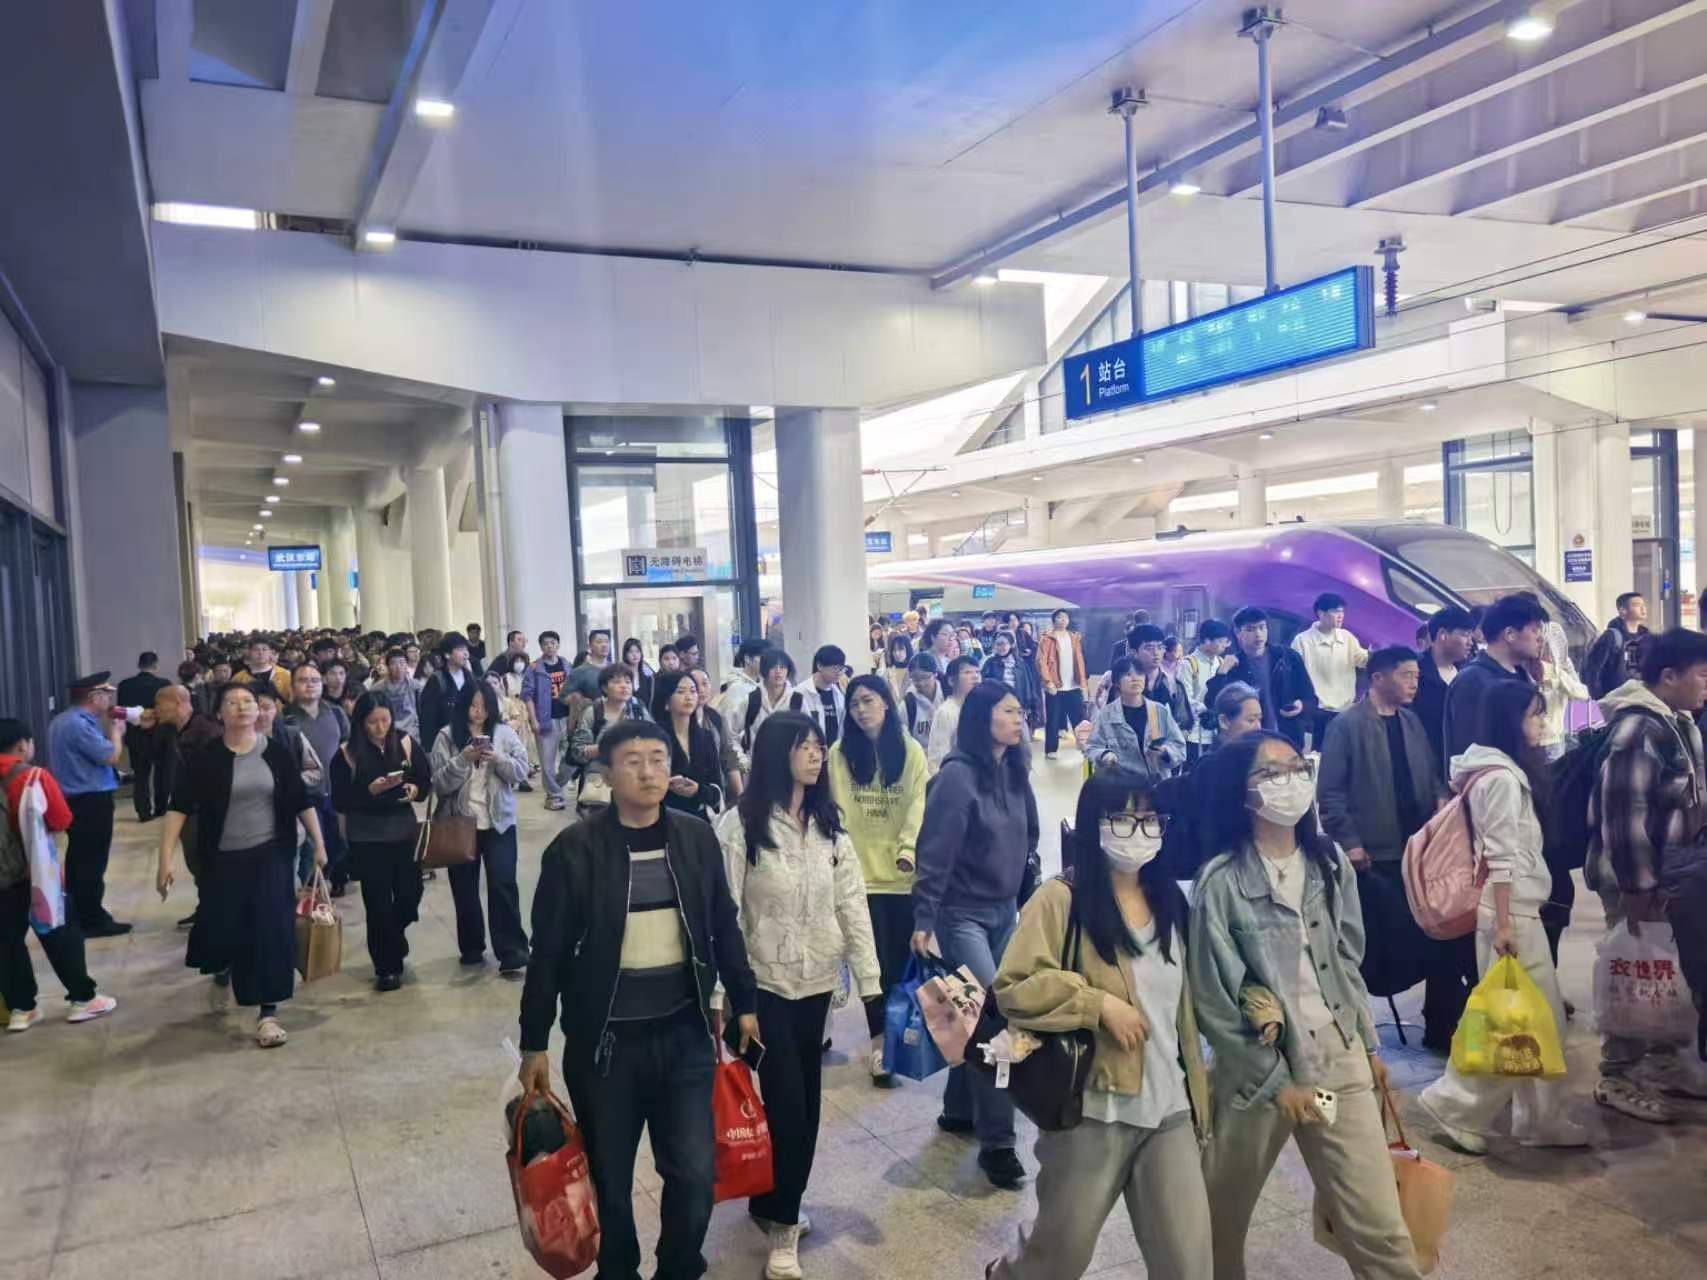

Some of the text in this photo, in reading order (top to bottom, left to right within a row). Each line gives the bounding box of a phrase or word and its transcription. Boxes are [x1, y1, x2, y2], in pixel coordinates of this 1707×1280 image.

[1097, 356, 1127, 383] 站台
[1080, 363, 1091, 406] 1
[1098, 383, 1130, 401] Platform
[649, 556, 704, 568] 无障碍电梯
